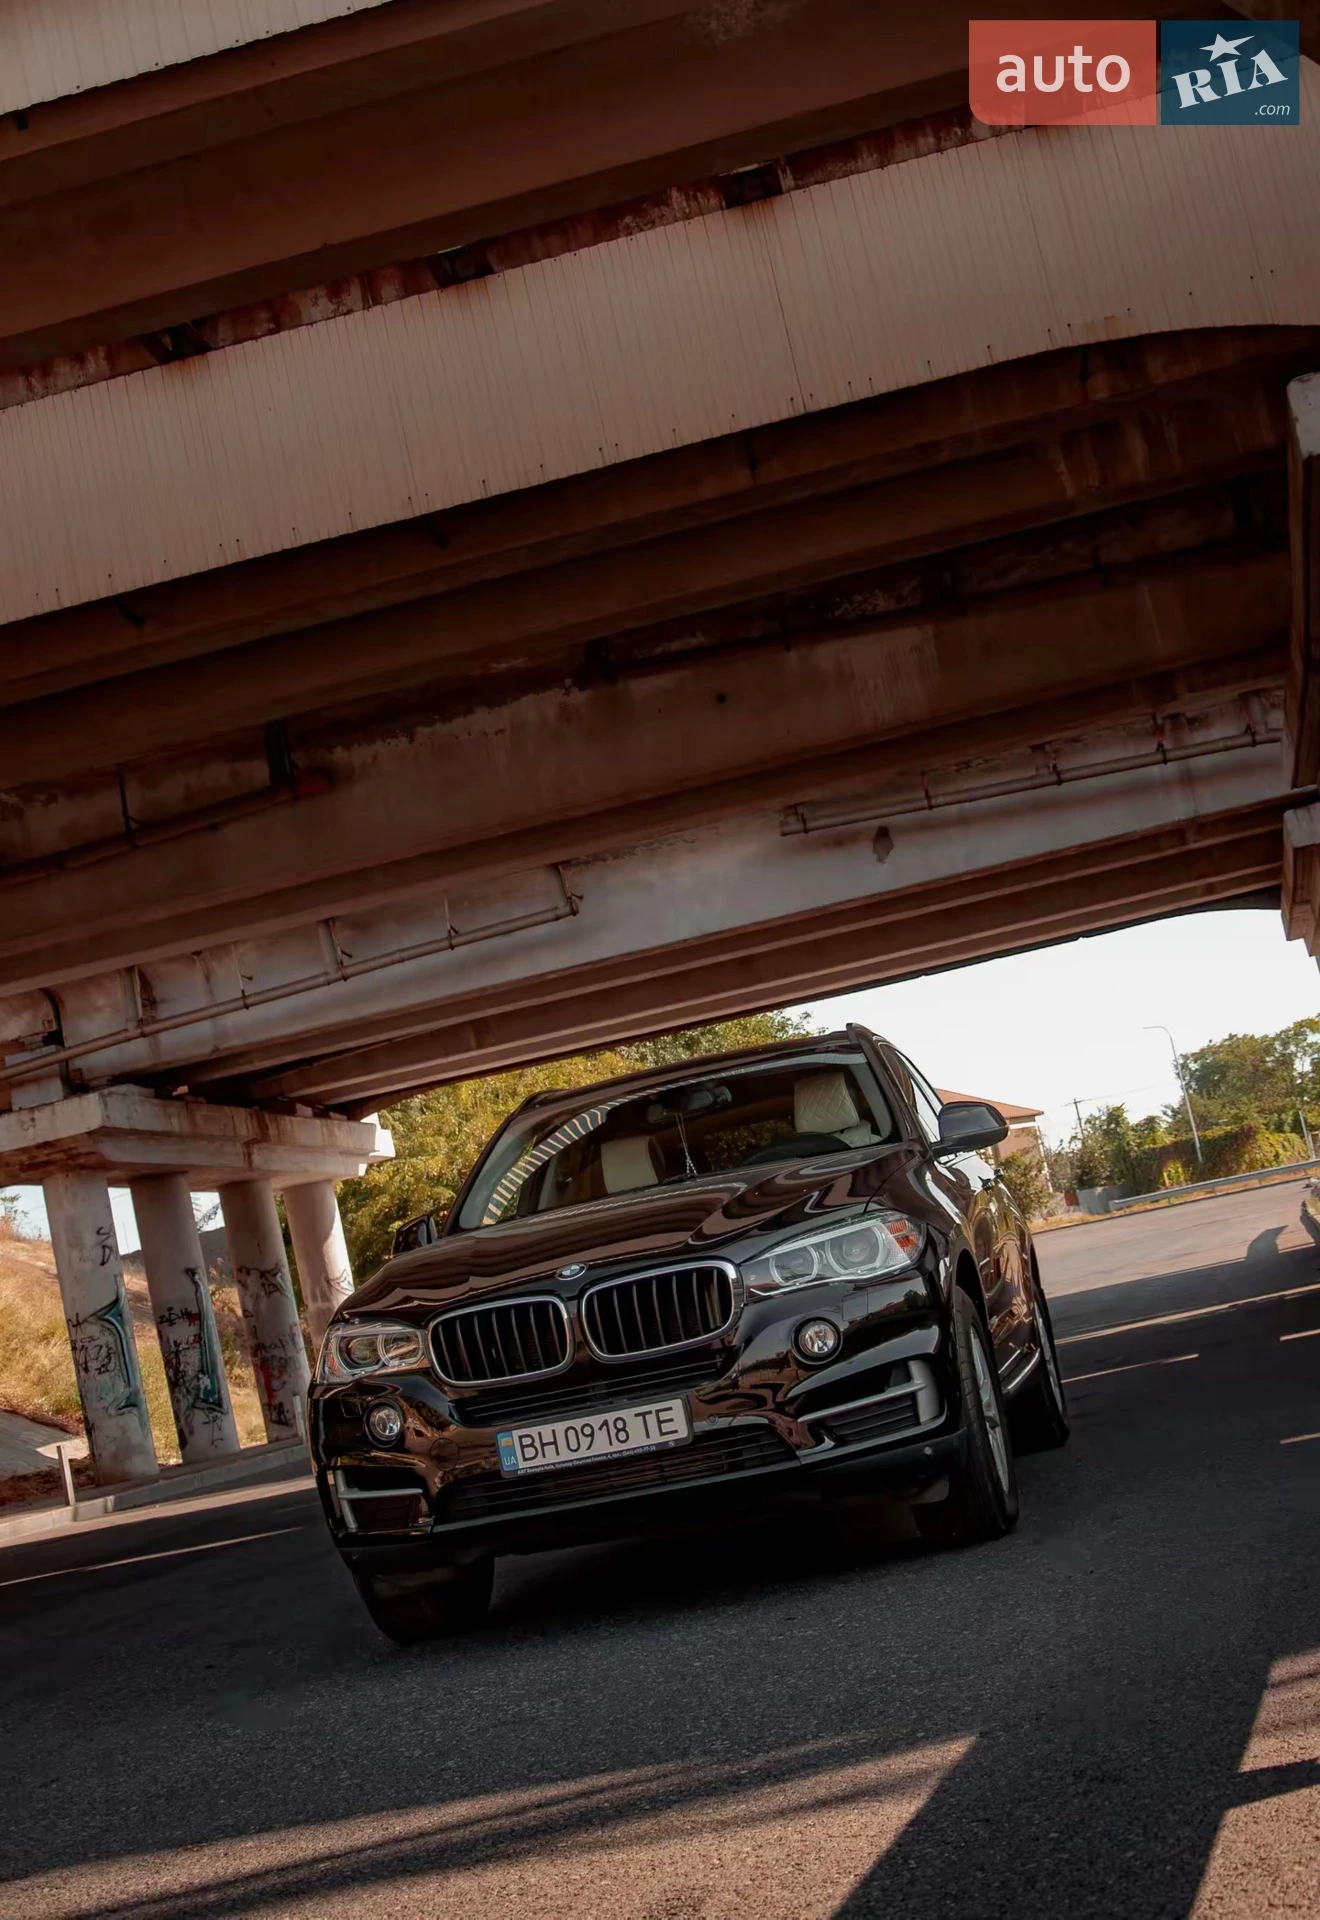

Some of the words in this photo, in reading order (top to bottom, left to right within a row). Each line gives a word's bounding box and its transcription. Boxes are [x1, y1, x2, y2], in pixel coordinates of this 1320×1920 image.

[518, 1429, 560, 1463] BH
[564, 1416, 630, 1453] 0918
[634, 1406, 679, 1440] TE
[504, 1456, 517, 1466] UA
